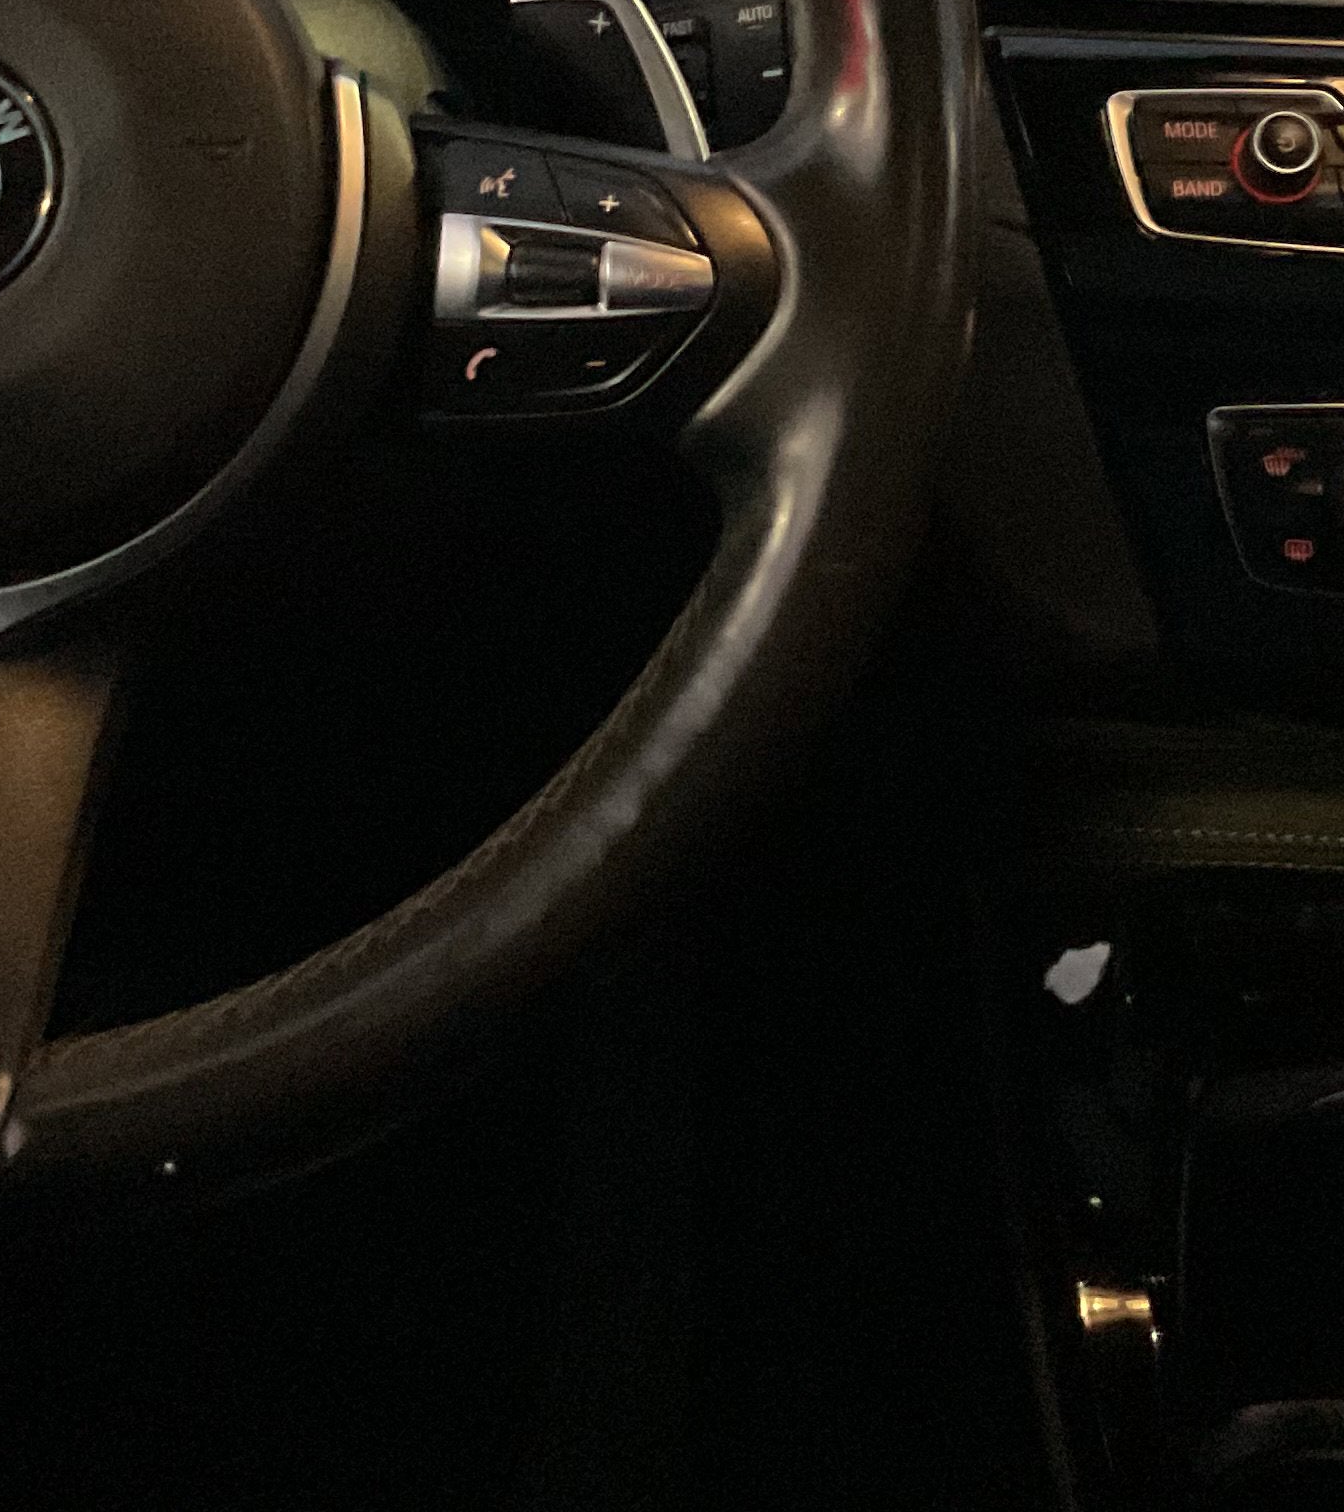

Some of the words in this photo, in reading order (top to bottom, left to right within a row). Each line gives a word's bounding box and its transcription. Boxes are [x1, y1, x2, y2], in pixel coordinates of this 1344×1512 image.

[737, 4, 774, 23] AUTO
[1163, 121, 1220, 140] MODE
[1172, 179, 1224, 199] BAND
